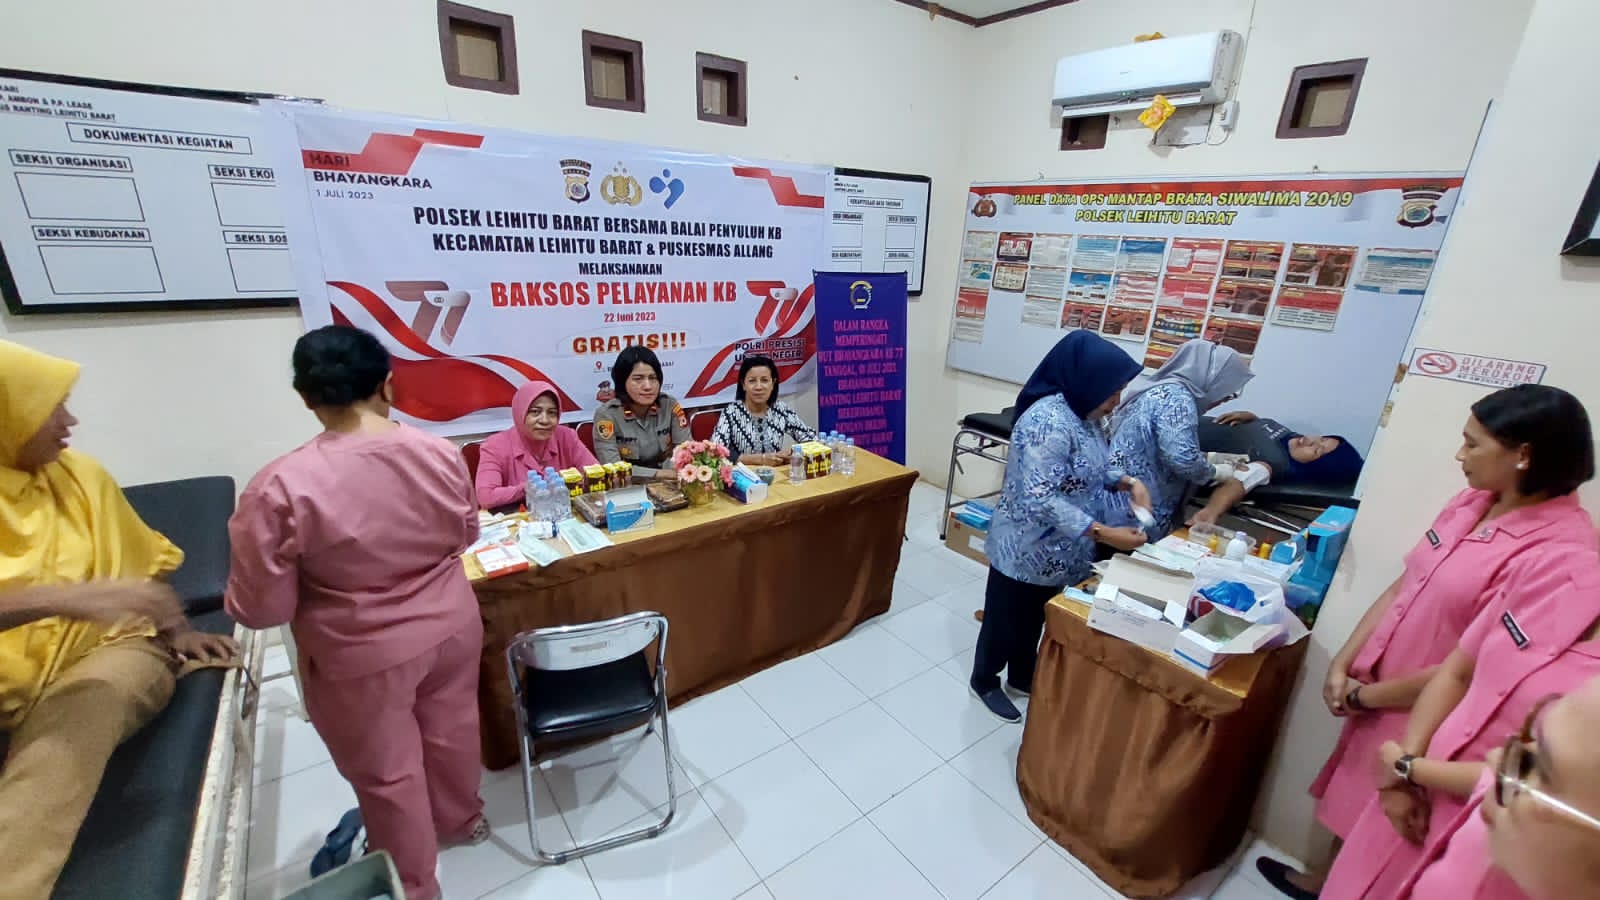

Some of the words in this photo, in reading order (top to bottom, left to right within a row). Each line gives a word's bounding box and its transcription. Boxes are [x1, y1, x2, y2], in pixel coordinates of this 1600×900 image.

[83, 127, 173, 146] DOKUMENTASI
[177, 134, 234, 150] KEGIATAN
[15, 153, 53, 166] SEKSI
[56, 156, 128, 170] ORGANISASI
[310, 152, 350, 167] HARI
[214, 166, 247, 178] SEKSI
[313, 170, 433, 190] BHAYANGKARA
[316, 189, 321, 197] 1
[324, 190, 345, 199] JULI
[348, 190, 375, 200] 2023
[1013, 194, 1046, 206] PANEL
[1049, 193, 1078, 206] DATA
[1080, 193, 1104, 206] OPS
[1107, 193, 1162, 206] MANTAP
[1165, 192, 1213, 206] BRATA
[1217, 191, 1302, 207] SIWALIMA
[1305, 191, 1354, 207] 2019
[413, 206, 483, 227] POLSEK
[486, 210, 549, 230] LEIHITU
[552, 214, 600, 232] BARAT
[604, 217, 668, 235] BERSAMA
[671, 221, 706, 237] BALAI
[709, 223, 765, 240] PENYULUH
[768, 226, 782, 240] KB
[1075, 209, 1124, 223] POLSEK
[1127, 210, 1182, 224] LEIHITU
[1184, 210, 1238, 225] BARAT
[37, 227, 72, 239] SEKSI
[74, 227, 146, 240] KEBUDAYAAN
[234, 233, 266, 243] SEKSI
[433, 233, 535, 253] KECAMATAN
[538, 236, 596, 254] LEIHITU
[599, 238, 642, 255] BARAT
[646, 243, 656, 256] &
[659, 241, 731, 258] PUSKESMAS
[734, 244, 773, 258] ALLANG
[578, 262, 663, 276] MELAKSANAKAN
[490, 281, 591, 307] BAKSOS
[596, 281, 708, 305] PELAYANAN
[713, 281, 737, 303] KB
[604, 313, 614, 323] 22
[617, 313, 634, 322] Juni
[636, 312, 656, 322] 2023
[834, 319, 859, 332] DALAM
[861, 319, 889, 331] RANGKA
[573, 331, 687, 354] GRATIS!!!
[735, 341, 765, 351] POLRI
[1461, 356, 1537, 375] DILARANG
[1459, 365, 1535, 384] MEROKOK
